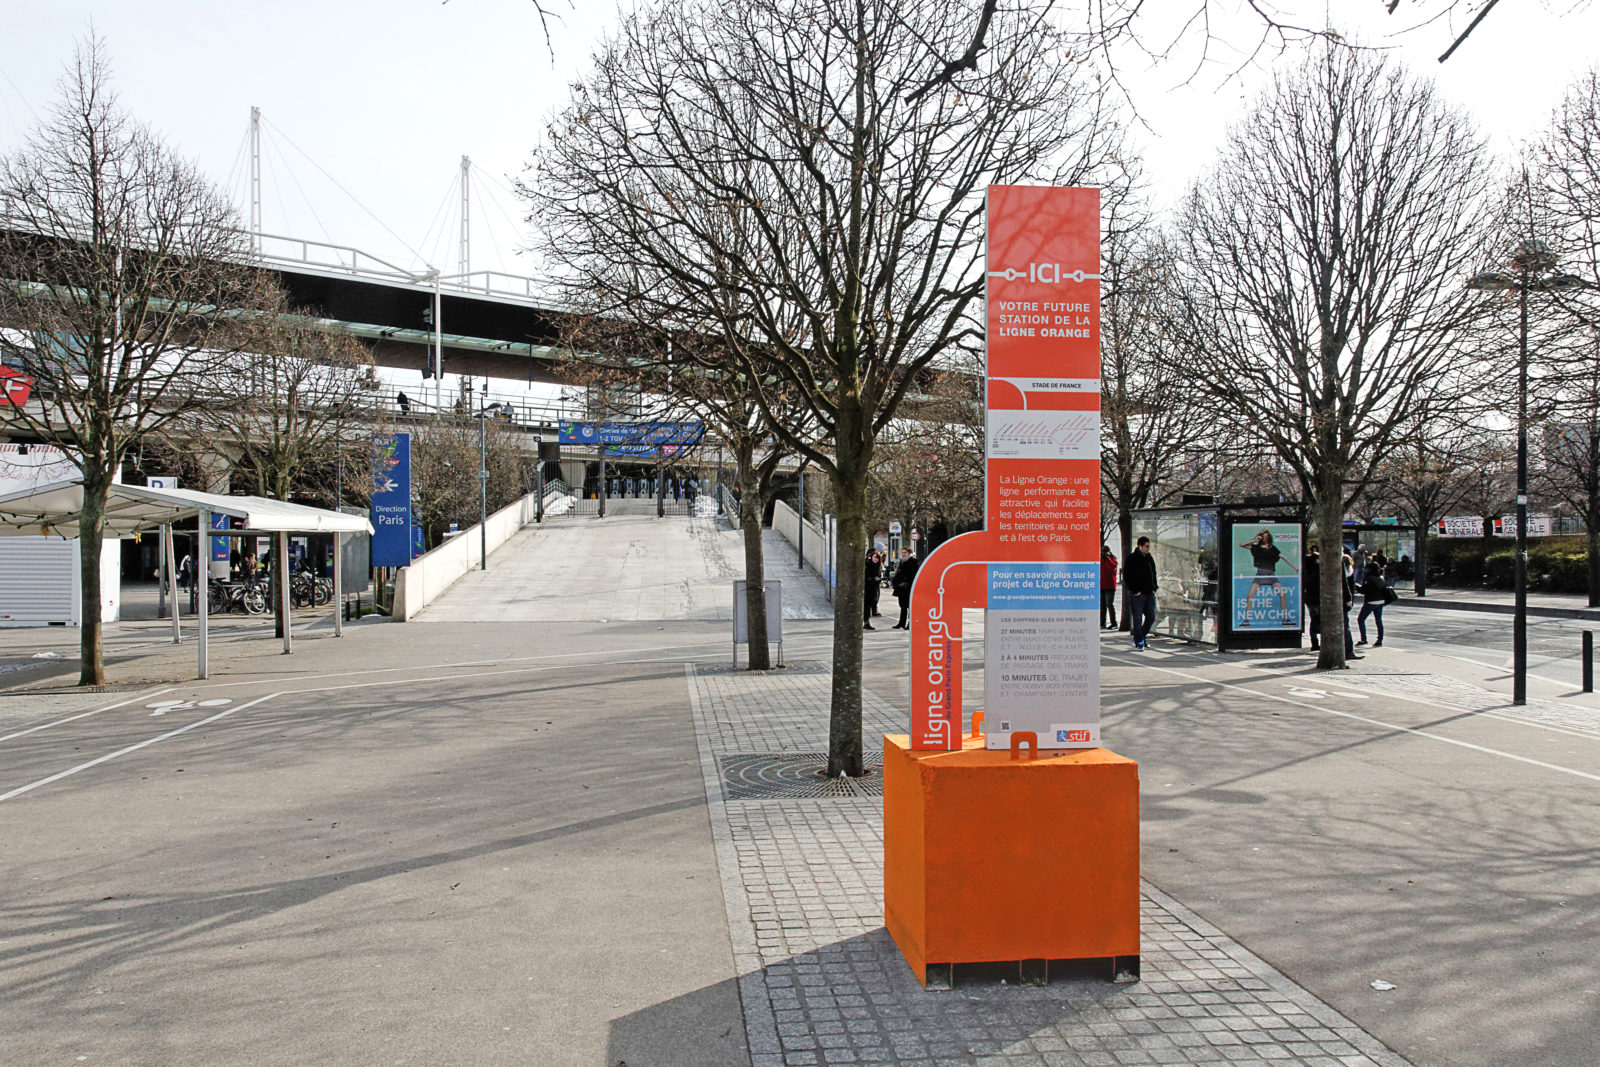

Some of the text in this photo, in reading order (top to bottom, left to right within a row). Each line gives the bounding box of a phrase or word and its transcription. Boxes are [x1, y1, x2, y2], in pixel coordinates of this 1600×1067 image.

[1029, 262, 1061, 284] ICI
[999, 301, 1091, 313] VOTRE FUTURE
[999, 314, 1091, 326] STATION DE LA
[999, 327, 1091, 338] LIGNE ORANGE
[999, 475, 1011, 484] La
[1012, 475, 1035, 486] Ligne
[1037, 475, 1067, 486] Orange
[999, 487, 1090, 497] ligne performante et
[375, 505, 407, 513] Direction
[999, 499, 1090, 509] attractive qui facilite
[378, 515, 404, 525] Paris
[999, 510, 1090, 520] les déplacements sur
[999, 521, 1090, 531] les territoires au nord
[999, 533, 1073, 542] et à l'est de Paris.
[992, 571, 1012, 579] Pour
[1026, 571, 1053, 579] savoir
[1053, 571, 1072, 581] plus
[1087, 571, 1096, 579] le
[992, 579, 1096, 590] projet de Ligne Orange
[1256, 586, 1296, 597] HAPPY
[1249, 598, 1273, 608] THE
[1237, 610, 1266, 620] NEW
[922, 607, 946, 745] ligne orange
[945, 710, 952, 720] du
[1069, 730, 1090, 742] stif
